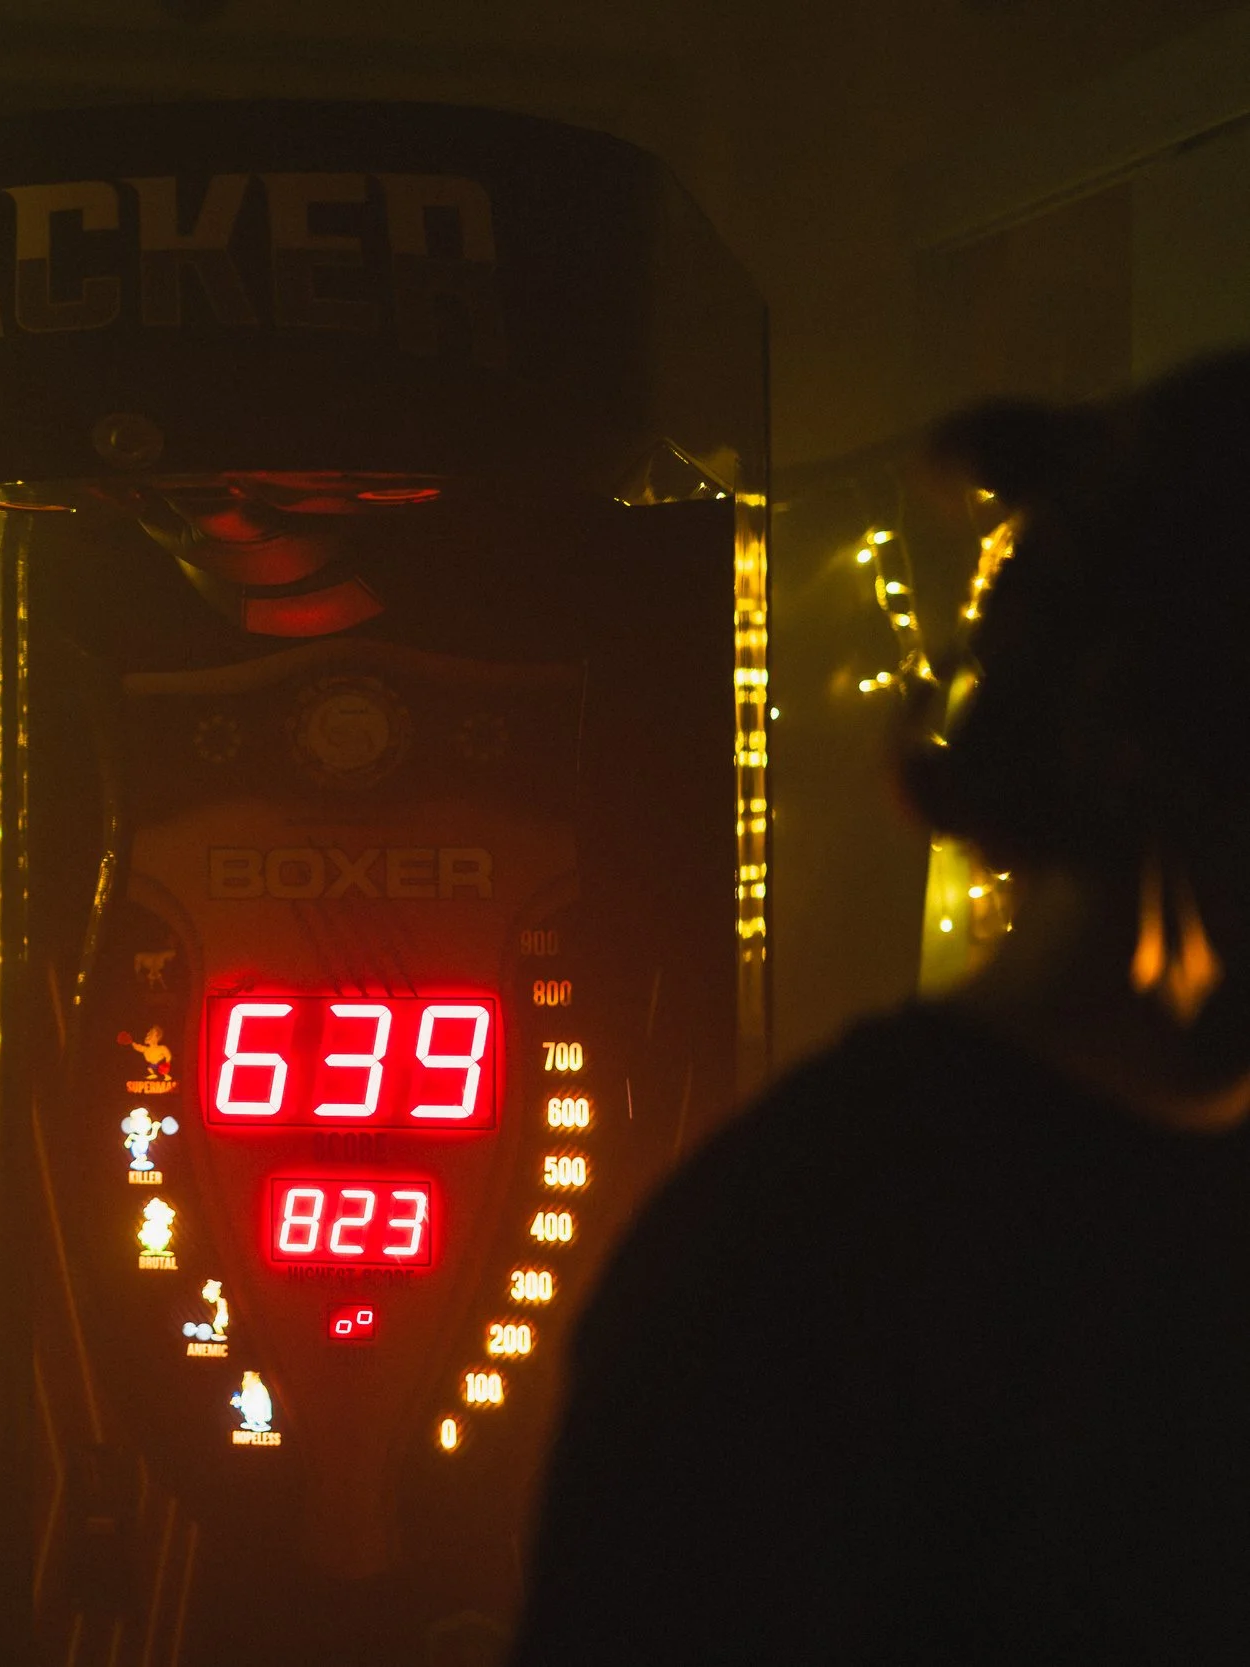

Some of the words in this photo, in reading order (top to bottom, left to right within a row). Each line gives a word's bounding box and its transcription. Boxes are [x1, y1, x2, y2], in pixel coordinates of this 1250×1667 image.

[208, 846, 494, 899] BOXER
[520, 930, 559, 956] 900
[533, 980, 572, 1007] 800
[215, 1003, 490, 1119] 639
[542, 1042, 584, 1072] 700
[126, 1081, 179, 1095] SUPERMA
[547, 1097, 590, 1128] 600
[128, 1170, 163, 1185] KILLER
[544, 1156, 587, 1187] 500
[278, 1188, 429, 1256] 823
[530, 1211, 573, 1242] 400
[138, 1256, 178, 1270] BRUTAL
[510, 1270, 553, 1301] 300
[186, 1342, 228, 1357] ANEMIC
[488, 1323, 532, 1355] 200
[465, 1372, 504, 1404] 100
[232, 1430, 282, 1446] HOPELESS
[440, 1418, 457, 1449] 0
